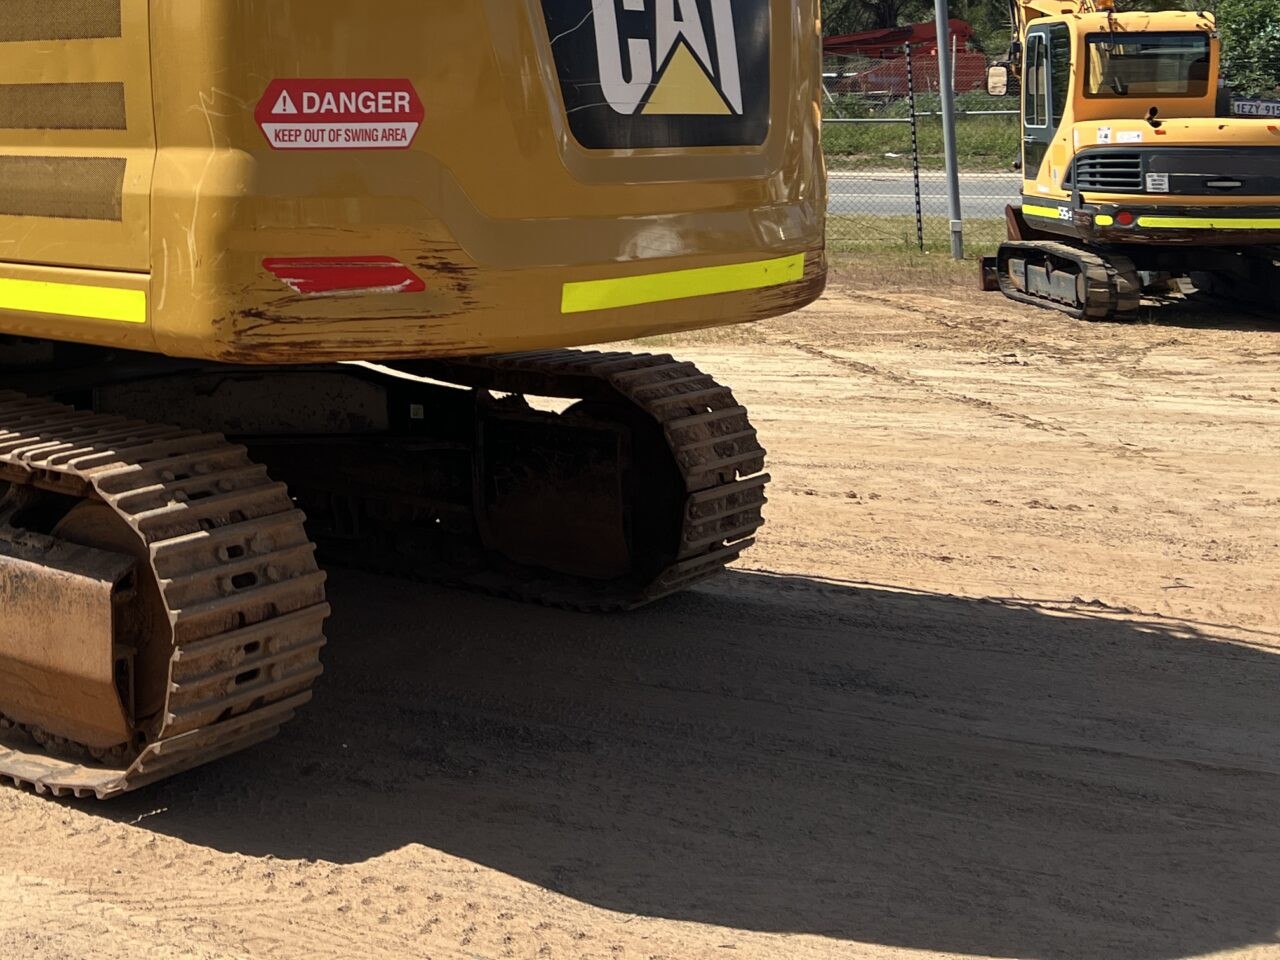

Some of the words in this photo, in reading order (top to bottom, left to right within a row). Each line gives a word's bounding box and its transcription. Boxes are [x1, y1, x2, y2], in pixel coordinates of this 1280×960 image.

[302, 91, 411, 114] DANGER
[1236, 103, 1261, 114] 1EZY
[274, 128, 302, 143] KEEP
[304, 128, 326, 142] OUT
[328, 128, 342, 142] OF
[344, 128, 379, 142] SWING
[381, 127, 407, 142] AREA
